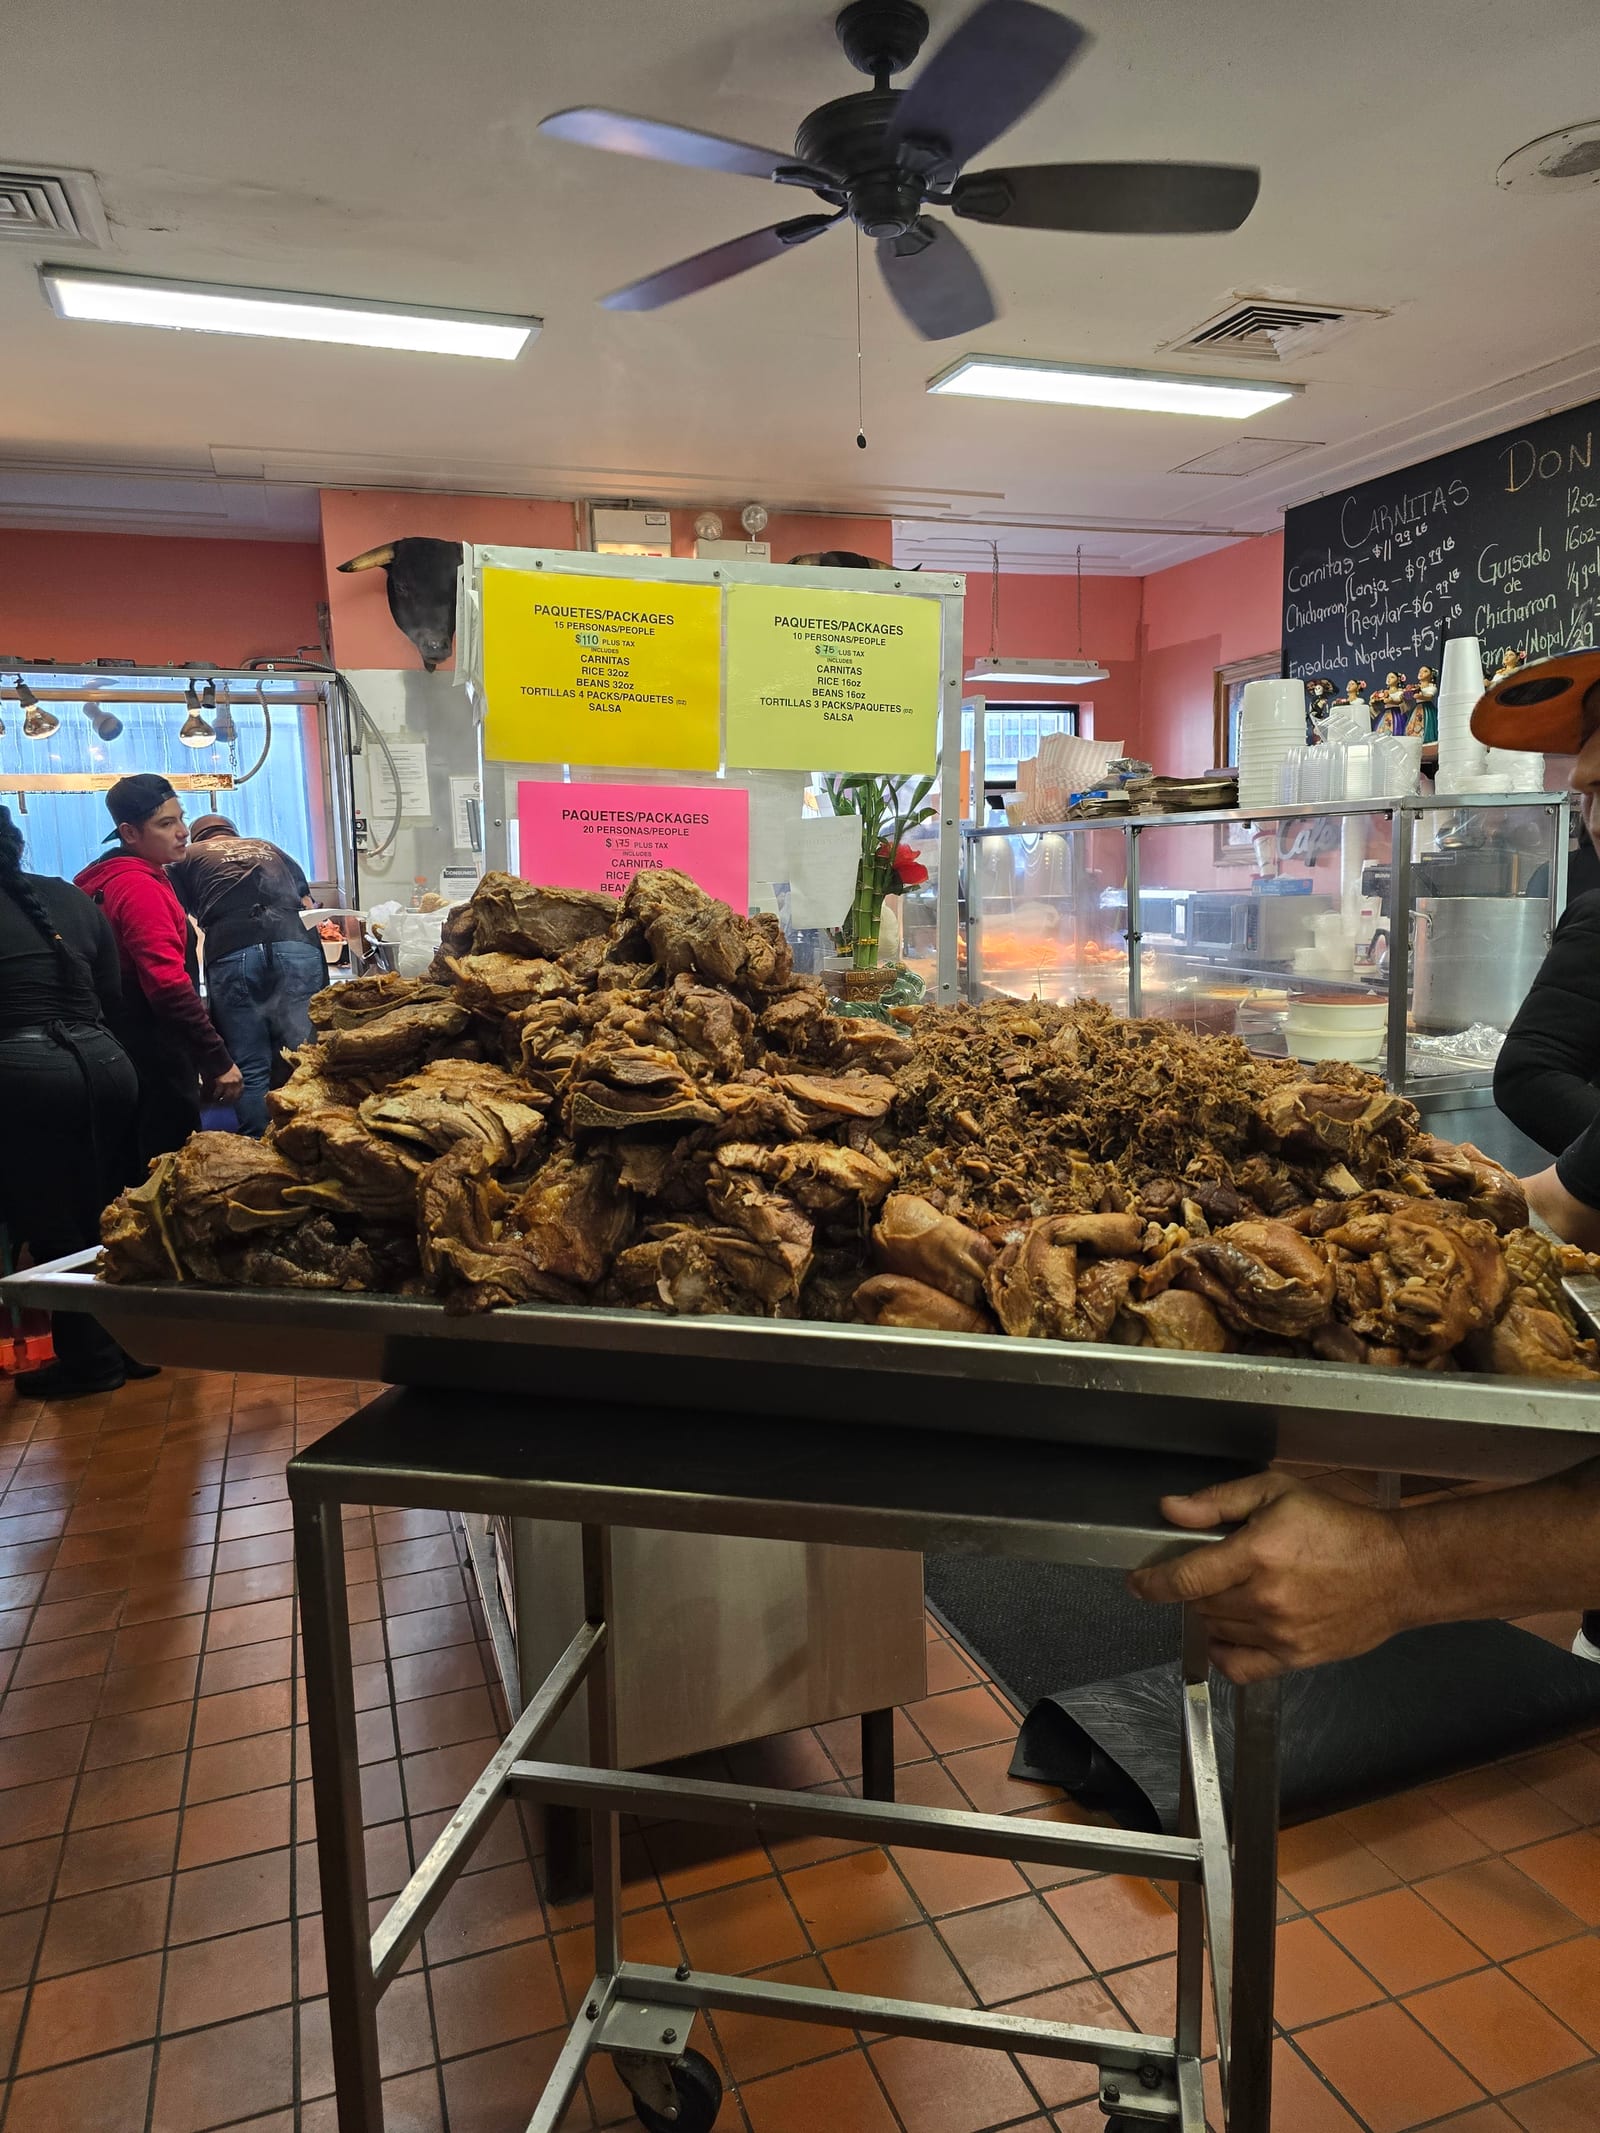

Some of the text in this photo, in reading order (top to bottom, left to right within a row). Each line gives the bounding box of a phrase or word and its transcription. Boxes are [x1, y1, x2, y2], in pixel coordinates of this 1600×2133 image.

[1341, 479, 1470, 549] CARNITAS
[1478, 526, 1551, 586] Guisado
[1288, 547, 1355, 593] Carnitas
[1503, 576, 1523, 595] de
[534, 604, 675, 626] PAQUETES/PACKAGES
[1286, 600, 1346, 633] Chicharron
[1474, 593, 1557, 636] Chicharron
[554, 620, 656, 636] 15 PERSONAS/PEOPLE
[774, 615, 904, 636] PAQUETES/PACKAGES
[602, 639, 621, 647] PLUS
[621, 640, 636, 648] TAX
[793, 632, 887, 646] 10 PERSONAS/PEOPLE
[839, 649, 852, 657] LUS
[853, 650, 865, 658] TAX
[1289, 643, 1349, 679] Ensalada
[1355, 632, 1403, 673] Nopales
[580, 654, 631, 667] CARNITAS
[827, 657, 853, 665] INCLUDES
[581, 666, 630, 678] RICE 32oz
[816, 664, 863, 676] CARNITAS
[576, 678, 635, 690] BEANS 32oz
[817, 677, 862, 688] RICE 16oz
[520, 686, 576, 699] TORTILLAS
[578, 690, 585, 699] 4
[587, 690, 674, 705] PACKS/PAQUETES
[812, 688, 866, 699] BEANS 16oz
[588, 702, 622, 714] SALSA
[760, 697, 812, 709] TORTILLAS
[814, 700, 820, 709] 3
[821, 701, 902, 713] PACKS/PAQUETES
[823, 712, 854, 722] SALSA
[562, 809, 710, 825] PAQUETES/PACKAGES
[583, 825, 690, 837] 20 PERSONAS/PEOPLE
[633, 841, 654, 849] PLUS
[611, 858, 664, 869] CARNITAS
[606, 871, 631, 880] RICE
